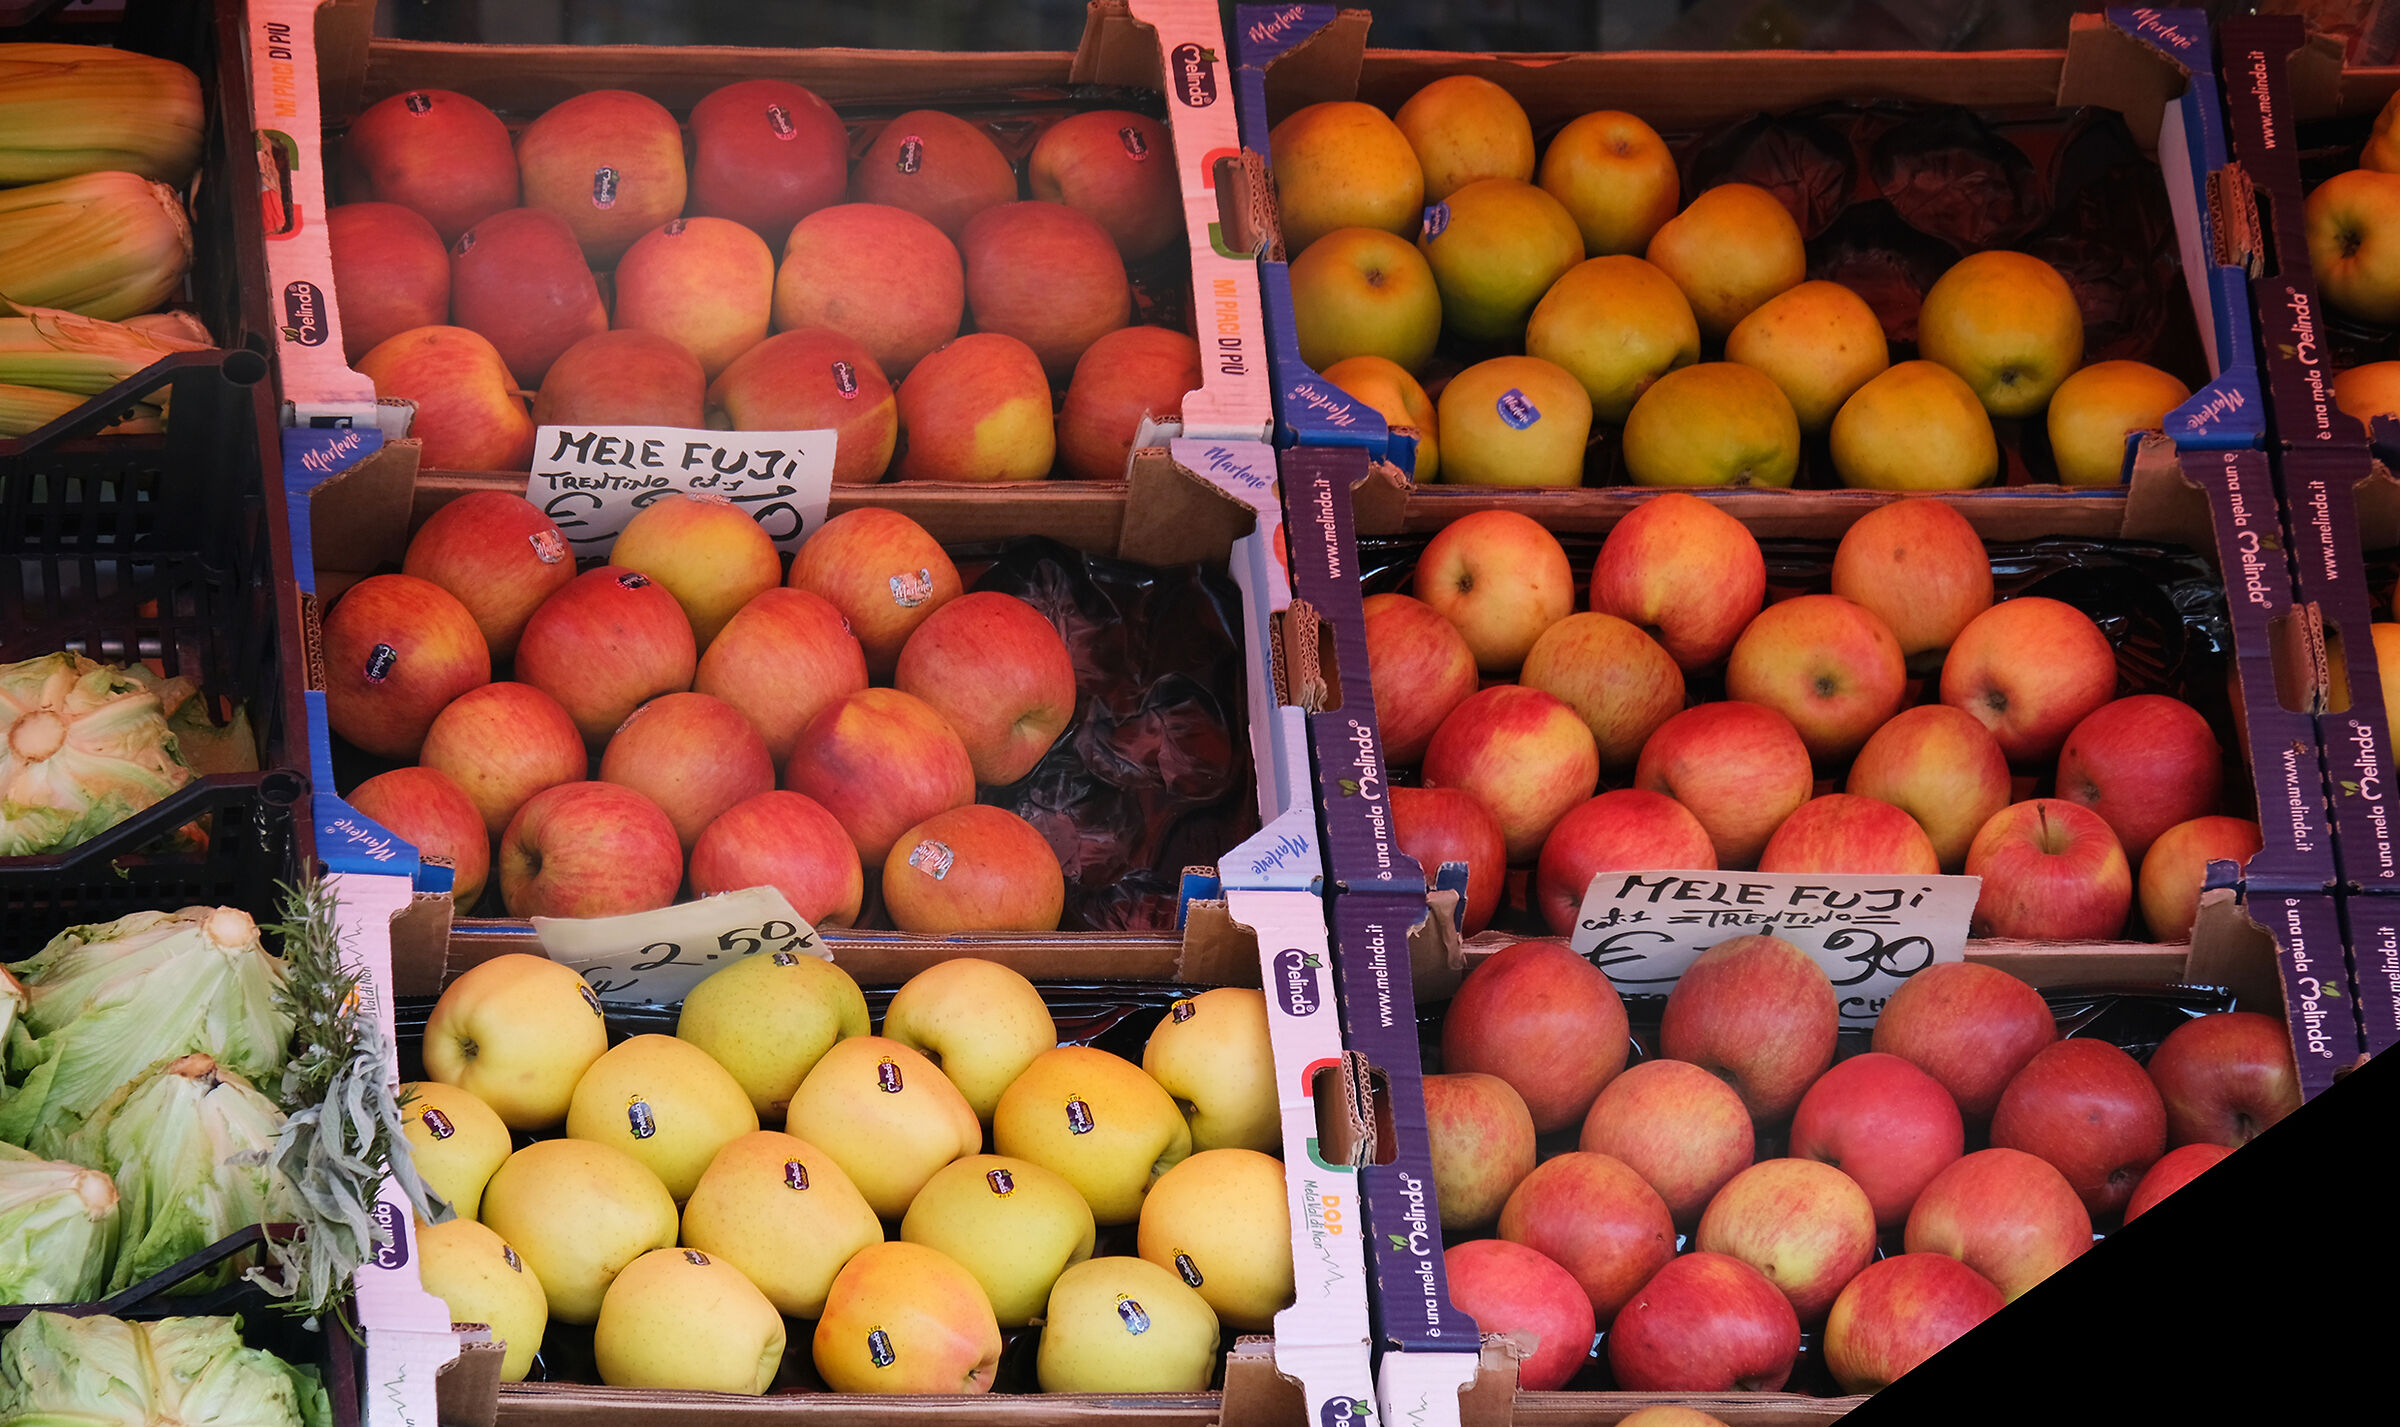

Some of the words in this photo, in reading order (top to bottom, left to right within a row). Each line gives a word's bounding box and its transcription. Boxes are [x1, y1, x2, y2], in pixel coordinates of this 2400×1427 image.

[263, 22, 292, 44] PIÙ
[1249, 5, 1305, 43] Marlene
[2132, 7, 2191, 49] Marlene
[269, 46, 293, 60] DI
[271, 61, 296, 98] PIACI
[274, 100, 296, 117] MI
[2248, 50, 2276, 150] www.melinda.it
[1213, 279, 1235, 298] MI
[1216, 300, 1241, 335] PIACI
[1218, 338, 1242, 352] DI
[1220, 354, 1251, 376] PIÙ
[2304, 370, 2322, 402] mela
[1295, 383, 1356, 428] Marlene
[2186, 388, 2245, 429] Marlene
[2314, 404, 2330, 429] una
[301, 432, 361, 472] Marlene
[550, 431, 665, 469] MELE
[2316, 431, 2331, 441] è
[1204, 446, 1266, 489] Marlene
[2224, 453, 2239, 462] è
[2225, 465, 2240, 490] una
[2230, 492, 2252, 527] mela
[1312, 479, 1342, 579] www.melinda.it
[2308, 481, 2338, 582] www.melinda.it
[2282, 750, 2314, 852] www.melinda.it
[1365, 806, 1387, 839] mela
[2367, 806, 2386, 839] mela
[334, 818, 397, 862] Marlene
[1252, 834, 1309, 875] Marlene
[1377, 843, 1392, 868] una
[2378, 841, 2393, 867] una
[1377, 871, 1393, 881] è
[2380, 869, 2394, 878] è
[1615, 876, 1775, 906] MELE
[2285, 898, 2300, 907] è
[2287, 909, 2303, 935] una
[2291, 938, 2313, 972] mela
[1365, 924, 1393, 1028] www.melinda.it
[1415, 1261, 1432, 1294] mela
[1425, 1301, 1439, 1326] una
[873, 1331, 889, 1365] Melinda
[1426, 1328, 1441, 1338] è
